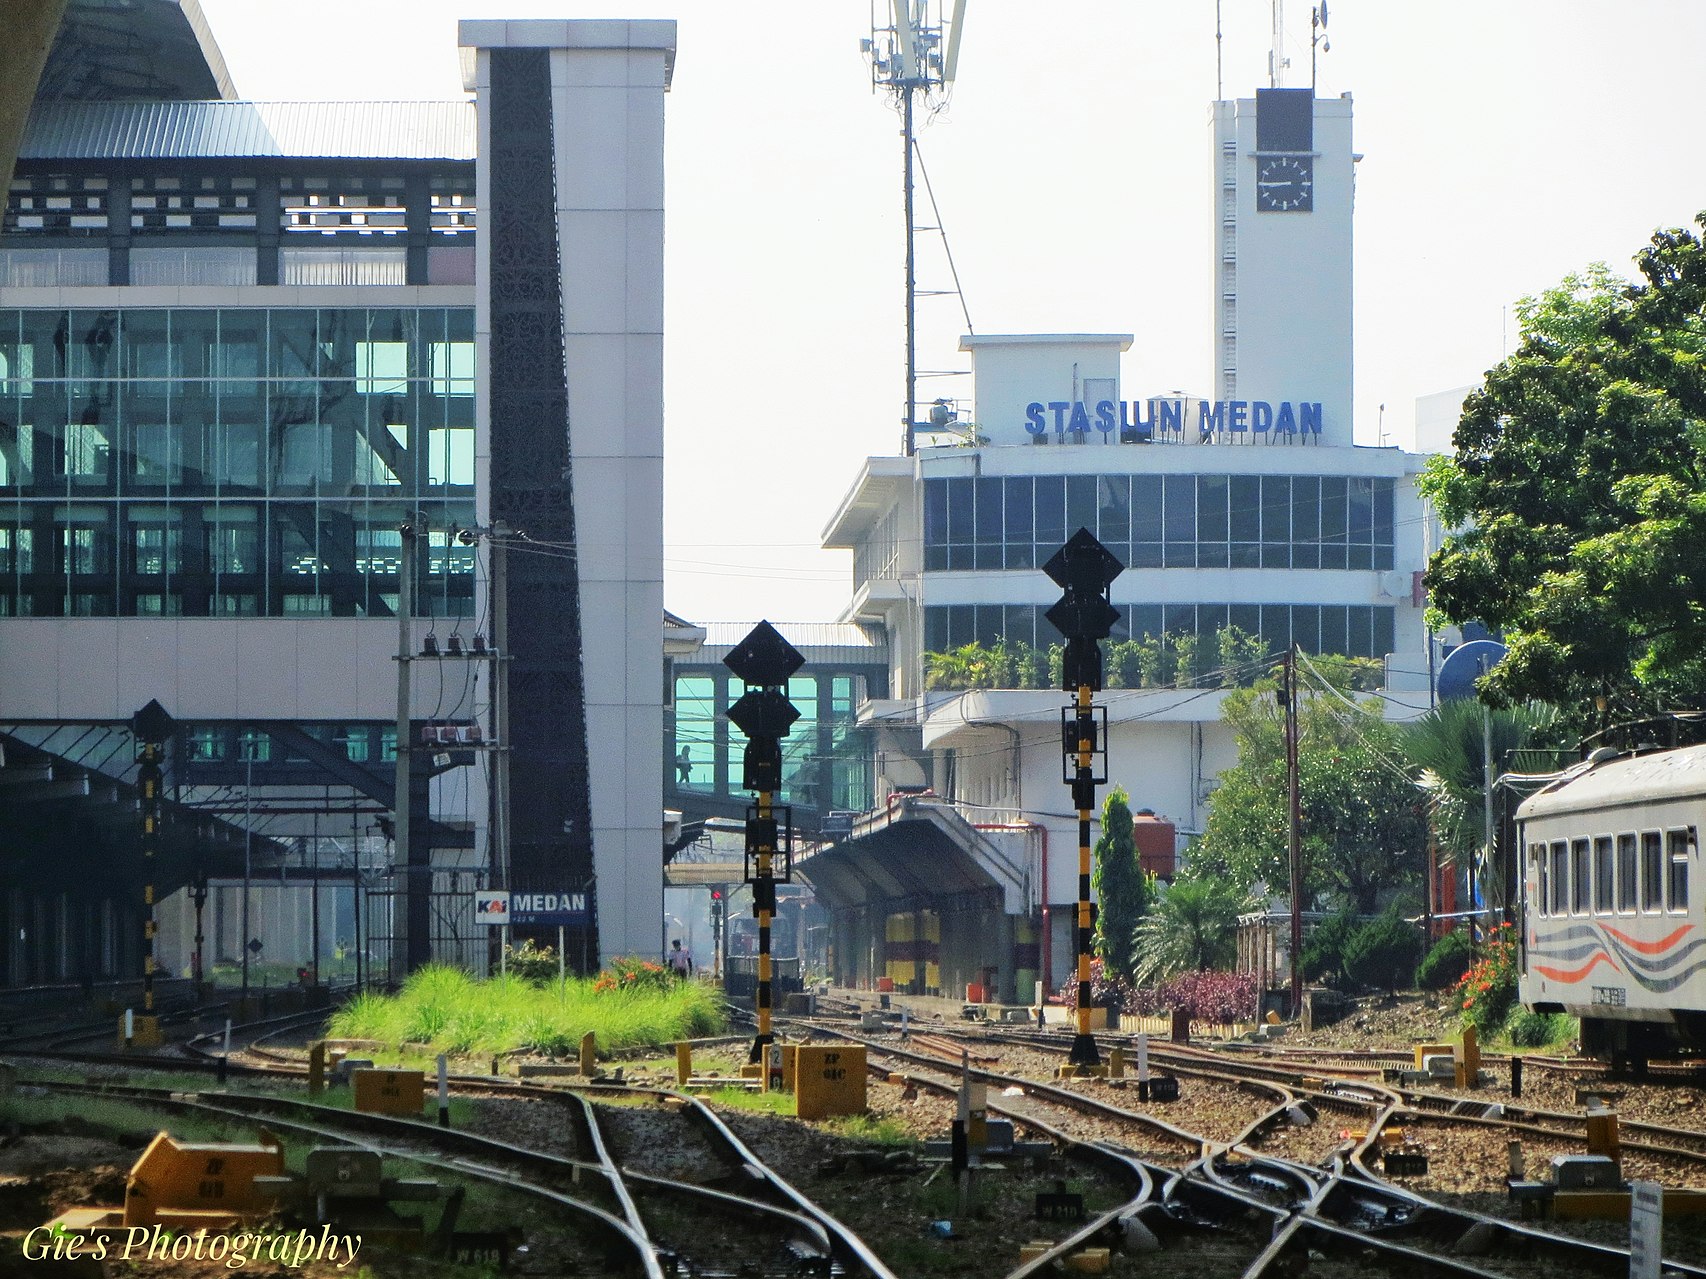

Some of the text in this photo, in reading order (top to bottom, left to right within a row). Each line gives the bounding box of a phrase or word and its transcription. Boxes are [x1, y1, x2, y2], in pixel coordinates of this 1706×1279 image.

[1024, 400, 1323, 434] STASIUN MEDAN
[513, 894, 586, 911] MEDAN
